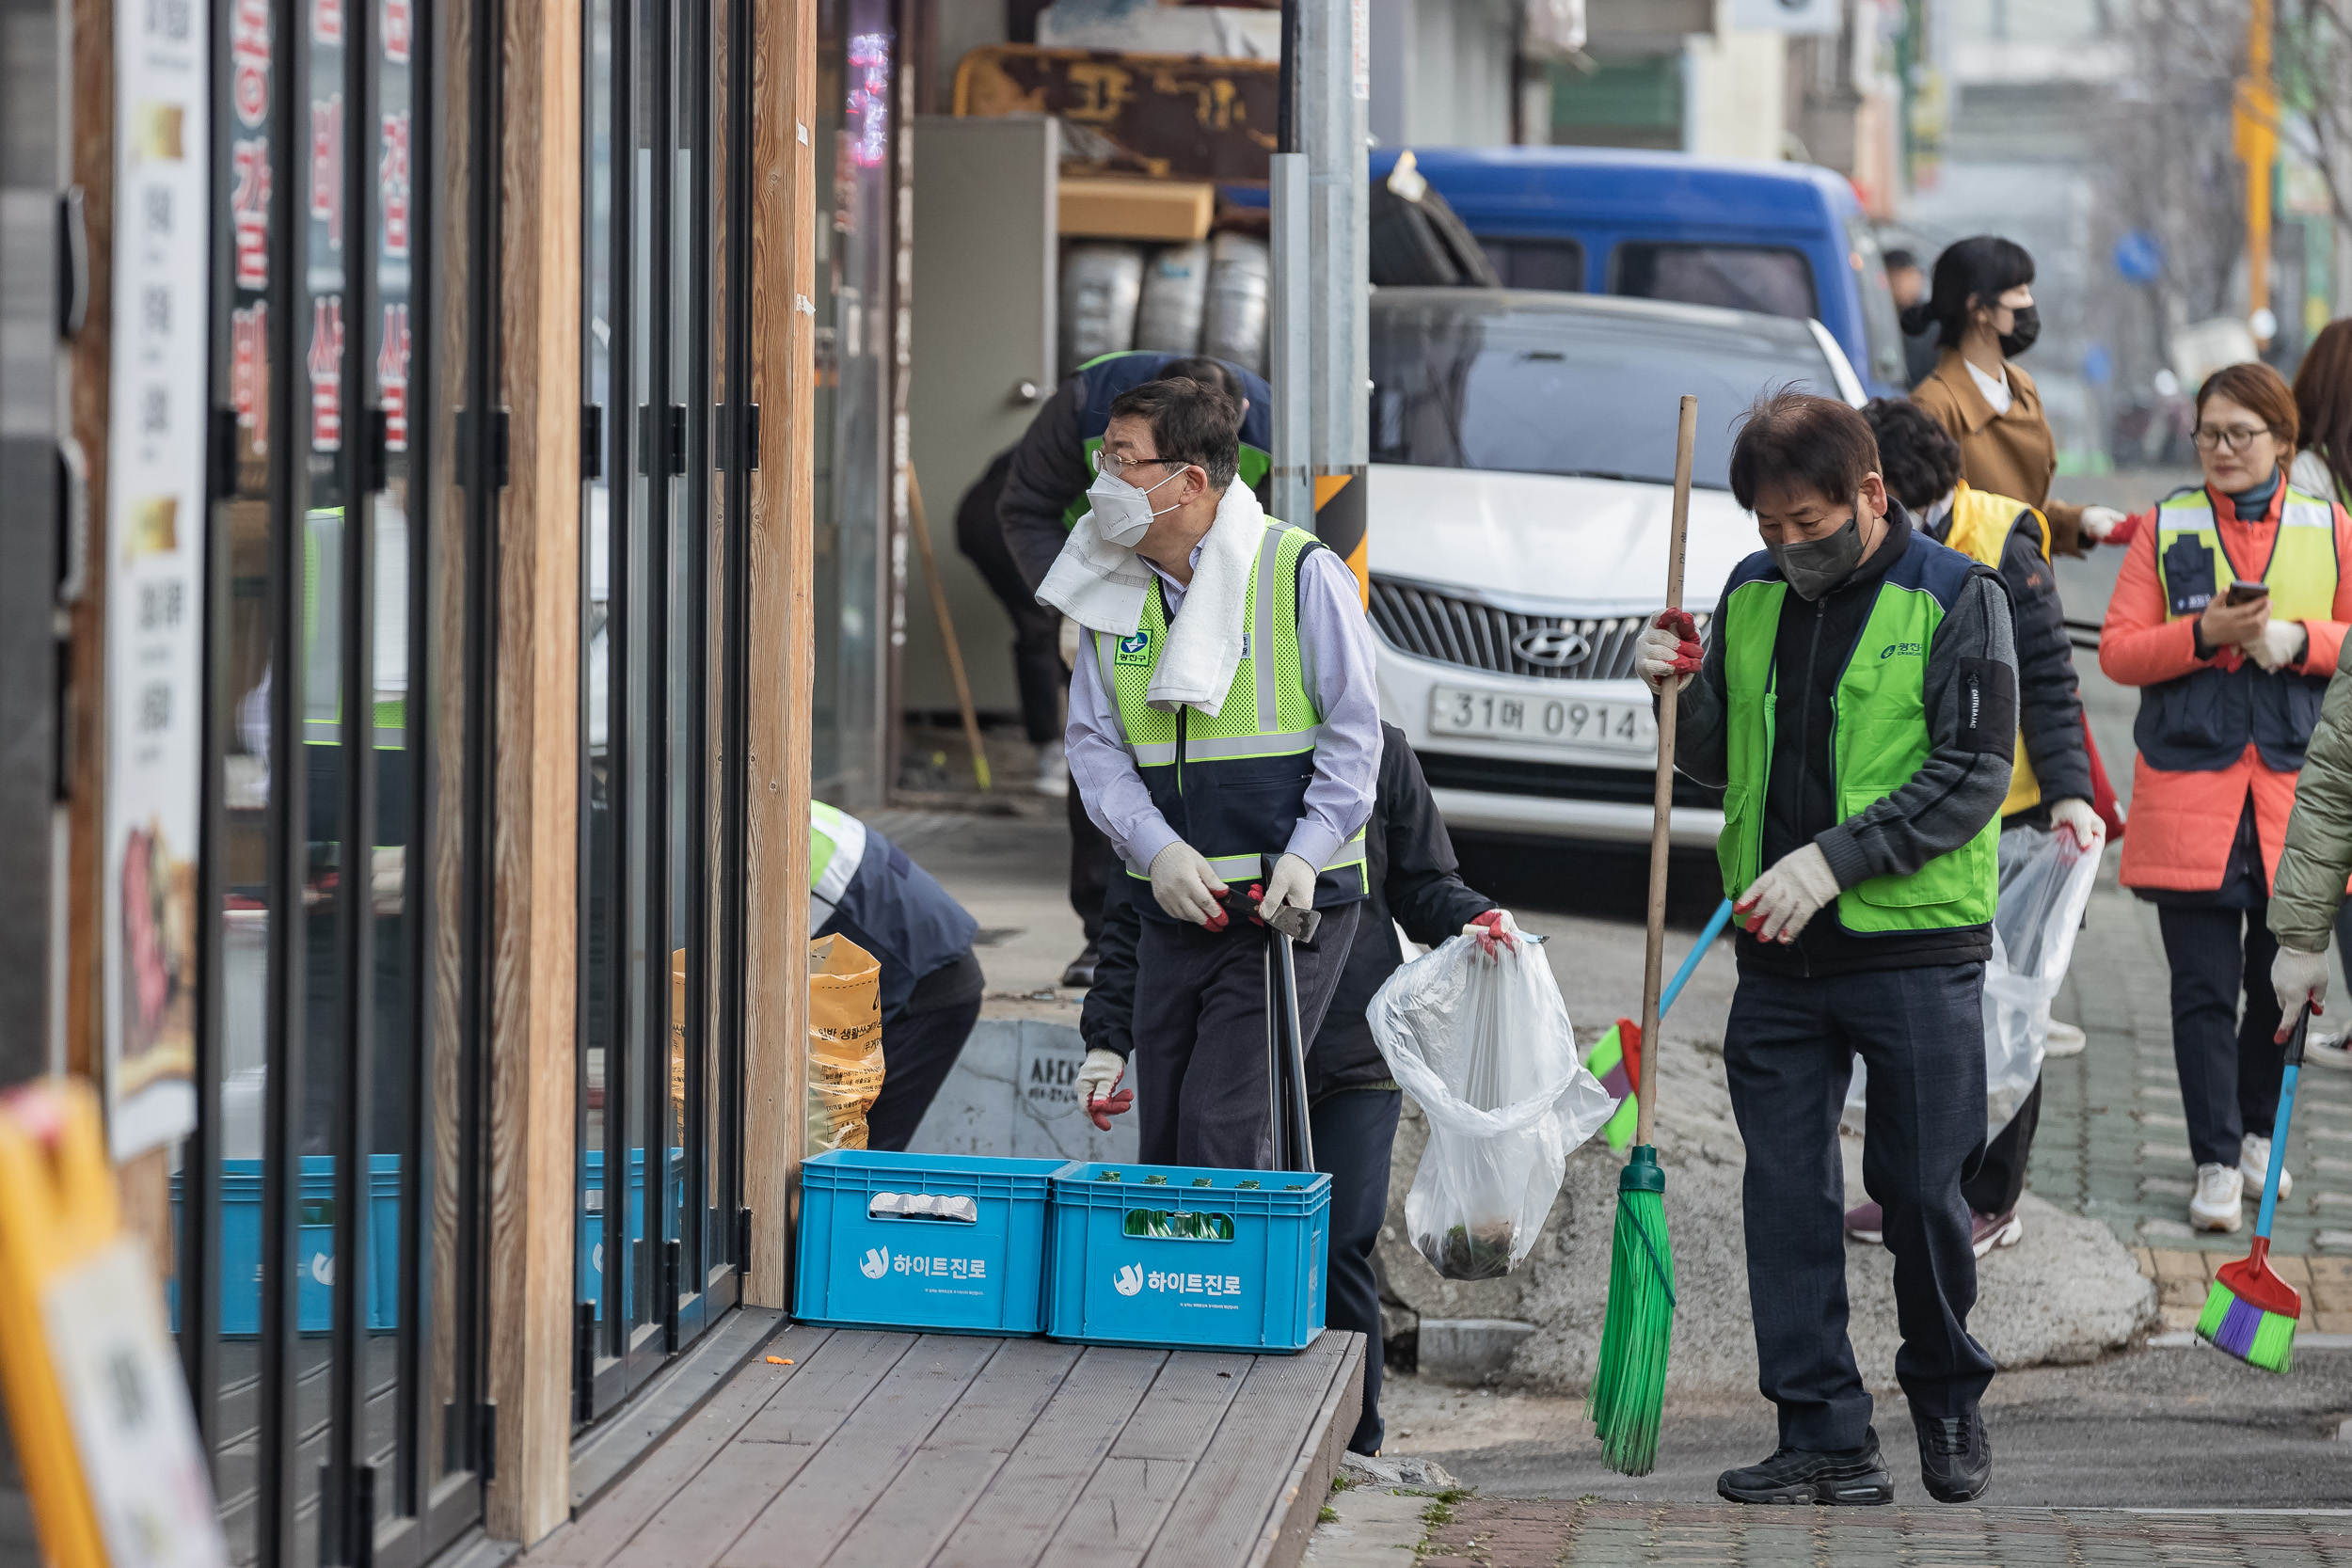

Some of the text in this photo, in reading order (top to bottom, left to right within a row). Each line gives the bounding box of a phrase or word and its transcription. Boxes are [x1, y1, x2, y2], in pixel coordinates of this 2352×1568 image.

[1119, 654, 1146, 662] 광진구
[1543, 701, 1636, 741] 0914
[1031, 1057, 1084, 1085] 사다
[894, 1254, 986, 1280] 하이트진로
[1148, 1271, 1241, 1296] 하이트진로
